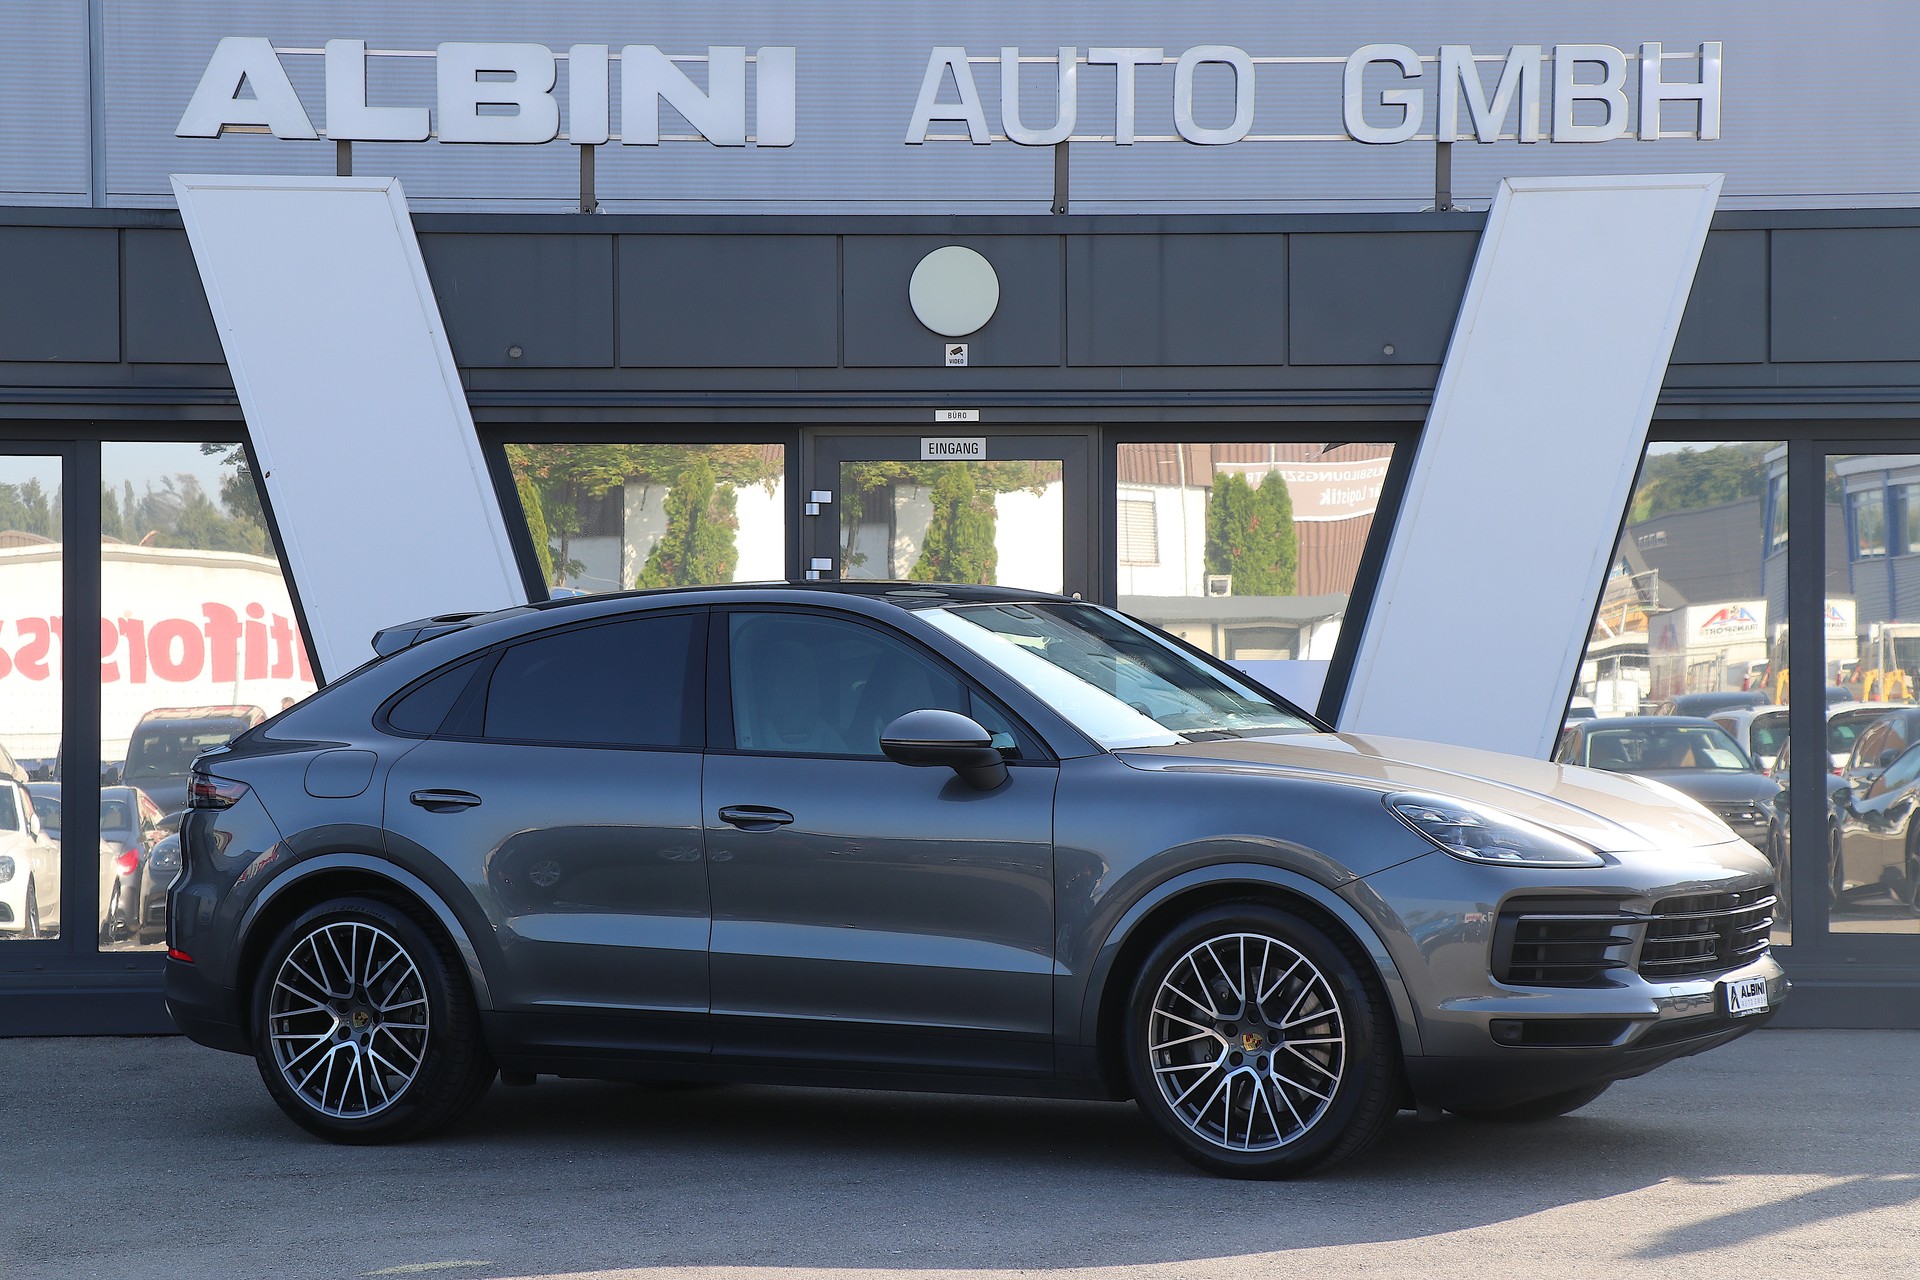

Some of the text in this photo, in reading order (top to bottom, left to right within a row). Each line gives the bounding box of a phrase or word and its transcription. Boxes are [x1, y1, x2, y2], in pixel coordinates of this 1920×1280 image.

[174, 36, 1723, 147] ALBINI AUTO GMBH
[947, 411, 967, 419] BÜRO
[928, 442, 979, 455] EINGANG
[1741, 982, 1765, 998] ALBINI
